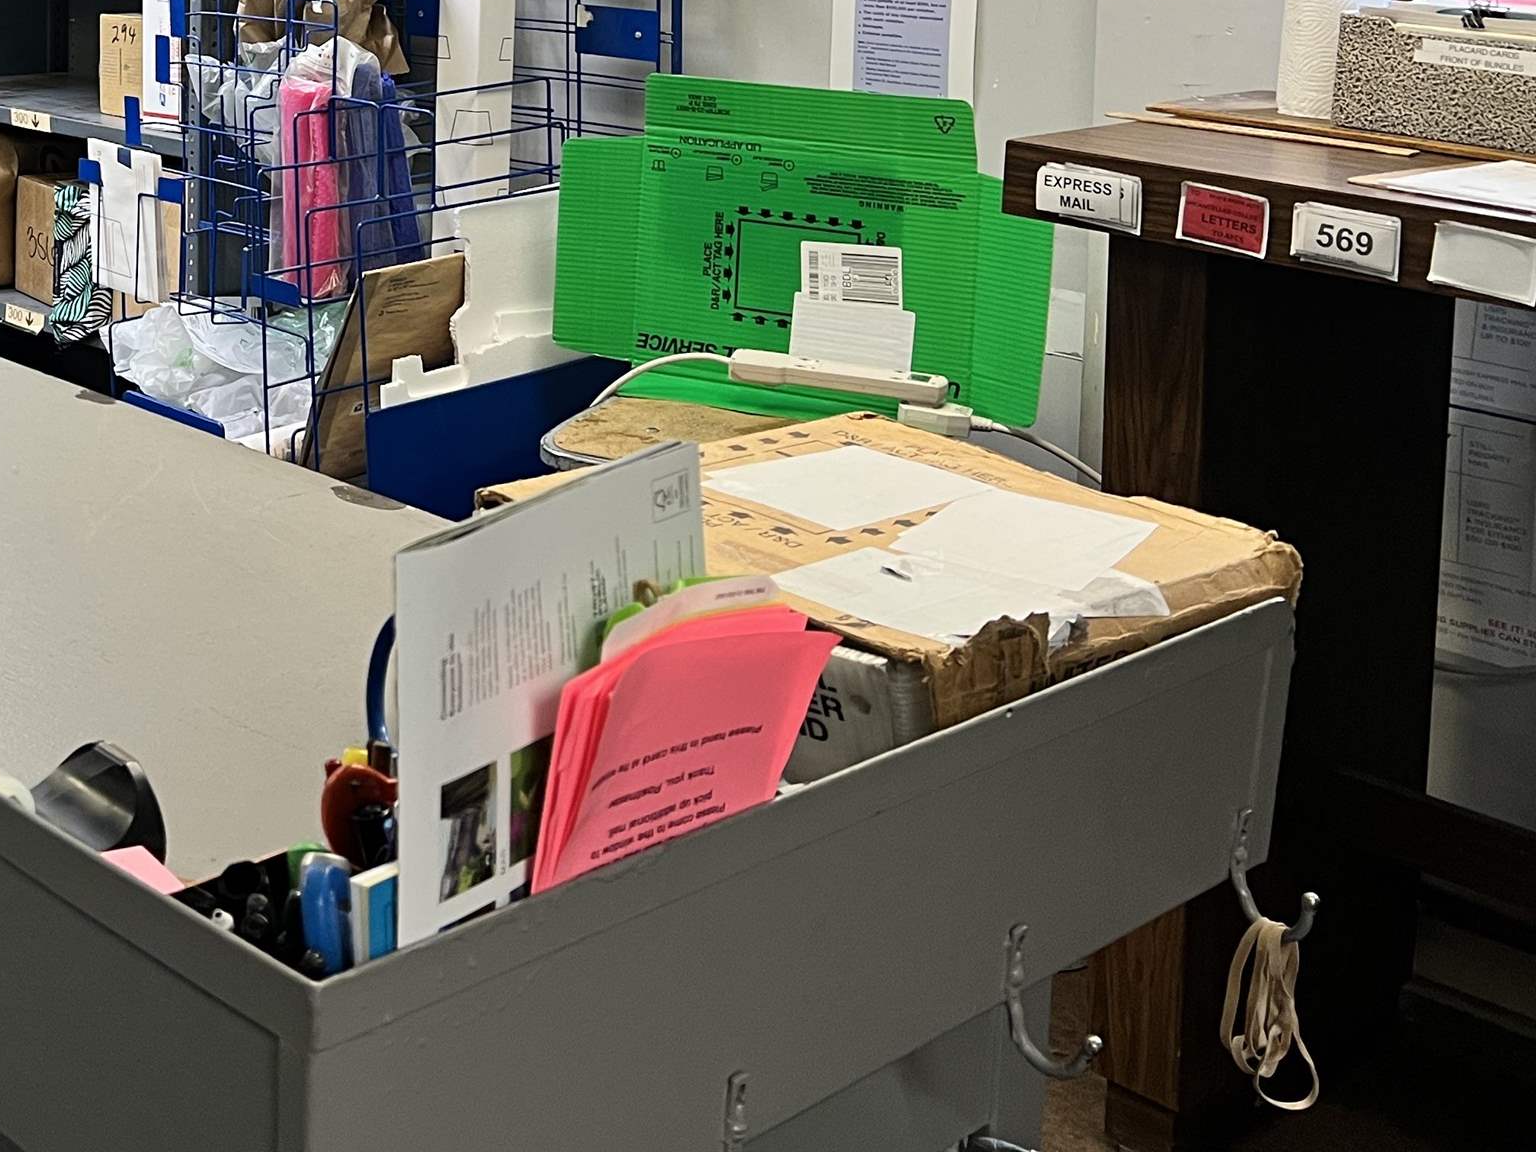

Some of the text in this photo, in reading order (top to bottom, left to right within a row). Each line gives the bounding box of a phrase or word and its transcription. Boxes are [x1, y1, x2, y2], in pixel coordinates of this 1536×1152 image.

[111, 24, 136, 45] 294
[1448, 43, 1521, 60] PLACARD CARDS
[1439, 54, 1525, 73] FRONT OF BUNDLES
[679, 135, 745, 151] APPLICATION
[1044, 174, 1113, 196] EXPRESS
[858, 199, 905, 213] WARNING
[1059, 194, 1096, 212] MAIL
[714, 212, 725, 238] HERE
[1200, 212, 1258, 236] LETTERS
[1315, 223, 1375, 256] 569
[702, 242, 713, 277] PLACE
[7, 305, 23, 322] 300
[1449, 618, 1521, 644] SUPPLIES CAN
[1487, 617, 1507, 630] SEE
[727, 724, 763, 737] Please
[669, 742, 688, 754] this
[700, 732, 726, 747] hand
[642, 749, 668, 766] card
[687, 764, 715, 780] Thank
[607, 782, 663, 809] Postmaster
[694, 788, 713, 804] pick
[678, 799, 691, 810] up
[695, 801, 726, 819] Please
[628, 803, 677, 828] additional
[667, 814, 694, 829] come
[637, 829, 655, 841] the
[656, 824, 666, 834] to
[601, 836, 635, 855] window
